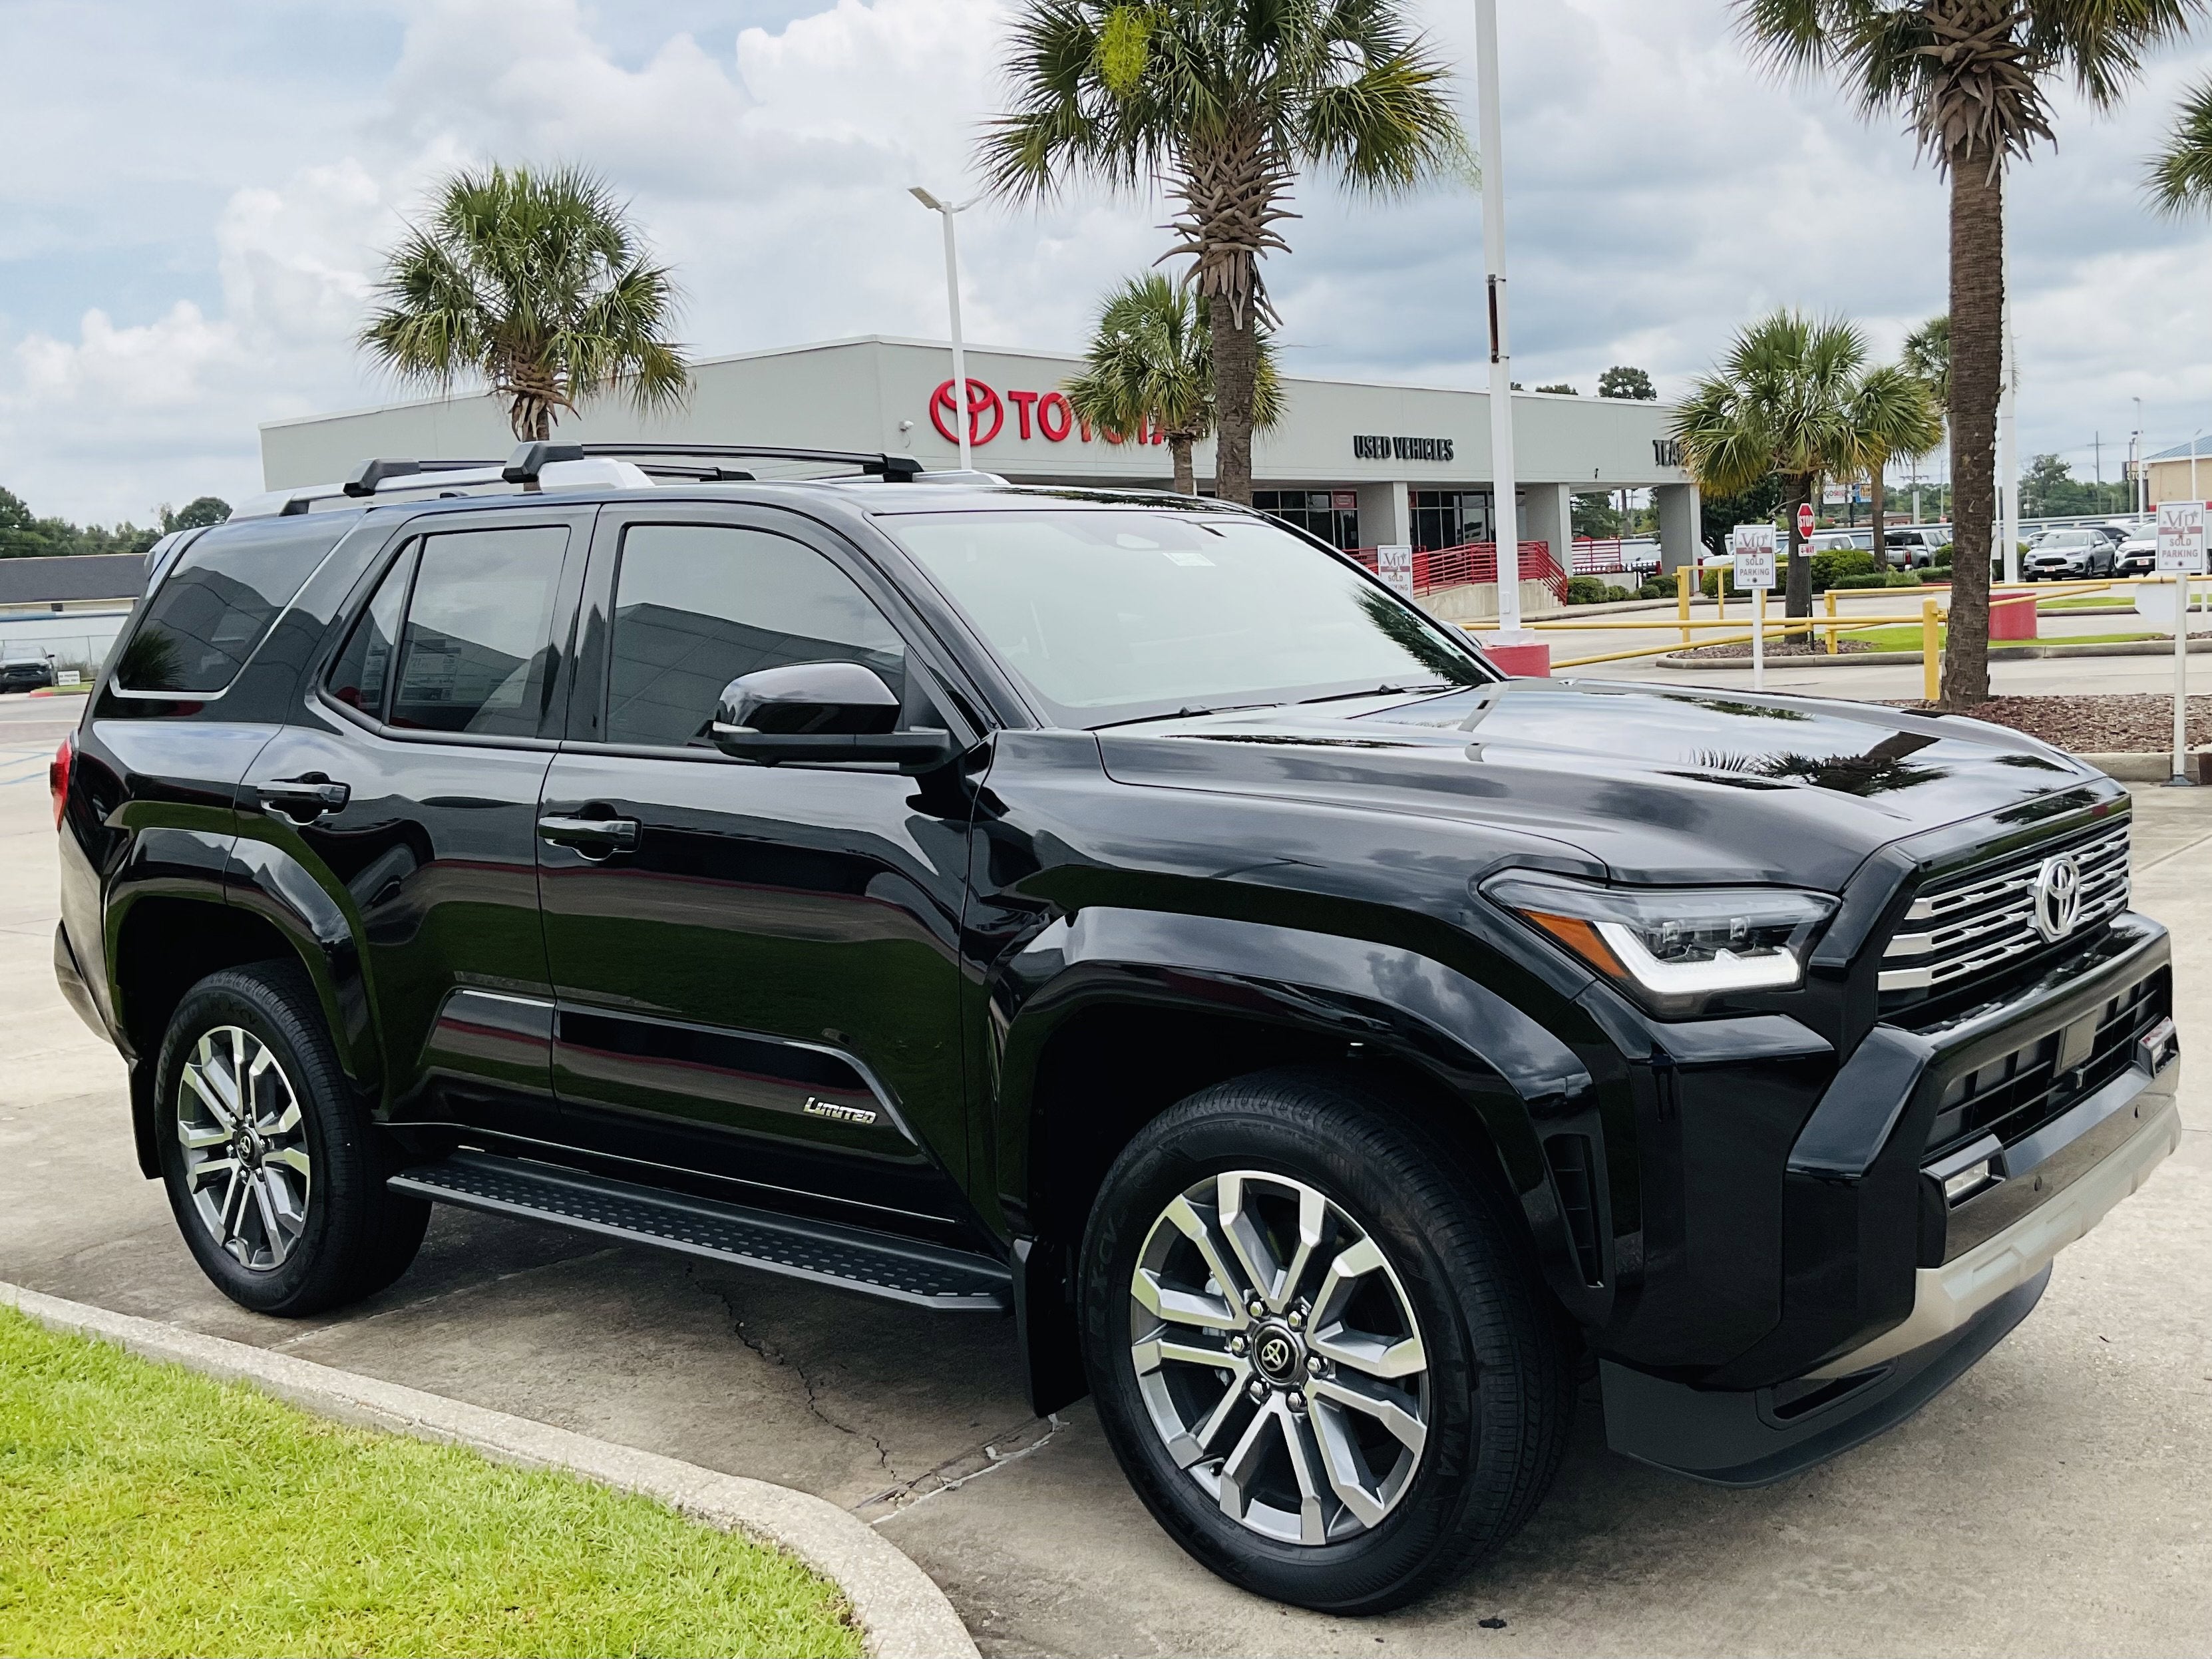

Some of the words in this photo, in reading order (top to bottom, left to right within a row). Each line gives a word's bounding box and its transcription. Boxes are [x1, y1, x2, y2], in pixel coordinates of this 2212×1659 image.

[1354, 435, 1391, 459] USED
[1392, 437, 1454, 461] VEHICLES
[1799, 515, 1813, 527] STOP
[1801, 545, 1815, 554] 4-WAY
[2161, 549, 2198, 558] PARKING
[803, 1096, 877, 1125] LIMITED
